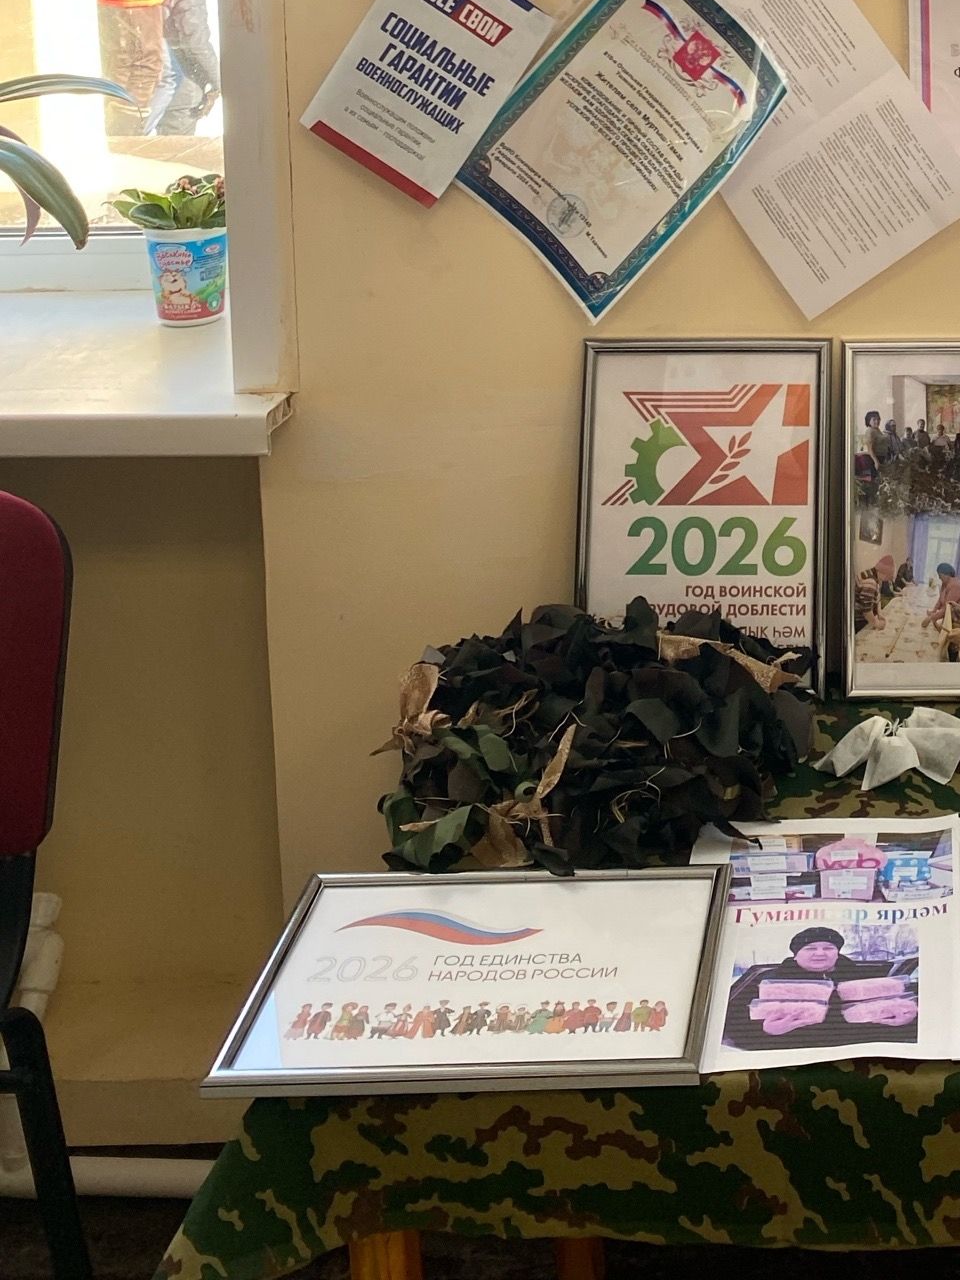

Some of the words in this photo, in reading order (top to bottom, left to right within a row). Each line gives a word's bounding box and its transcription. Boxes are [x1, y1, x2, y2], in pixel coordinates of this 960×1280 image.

[457, 2, 504, 43] СВОИ
[379, 11, 495, 97] СОЦИАЛЬНЫЕ
[378, 41, 467, 111] ГАРАНТИИ
[595, 70, 626, 101] Жителям
[624, 98, 642, 116] села
[355, 56, 464, 134] ВОЕННОСЛУЖАЩИХ
[625, 516, 807, 577] 2026
[686, 585, 715, 600] ГОД
[720, 582, 807, 598] ВОИНСКОЙ
[726, 603, 807, 618] ДОБЛЕСТИ
[877, 902, 948, 924] ярдәм
[306, 954, 419, 983] 2026
[428, 969, 527, 983] НАРОДОВ
[531, 967, 618, 980] РОССИИ
[433, 954, 475, 968] ГОД
[479, 953, 583, 967] ЕДИНСТВА
